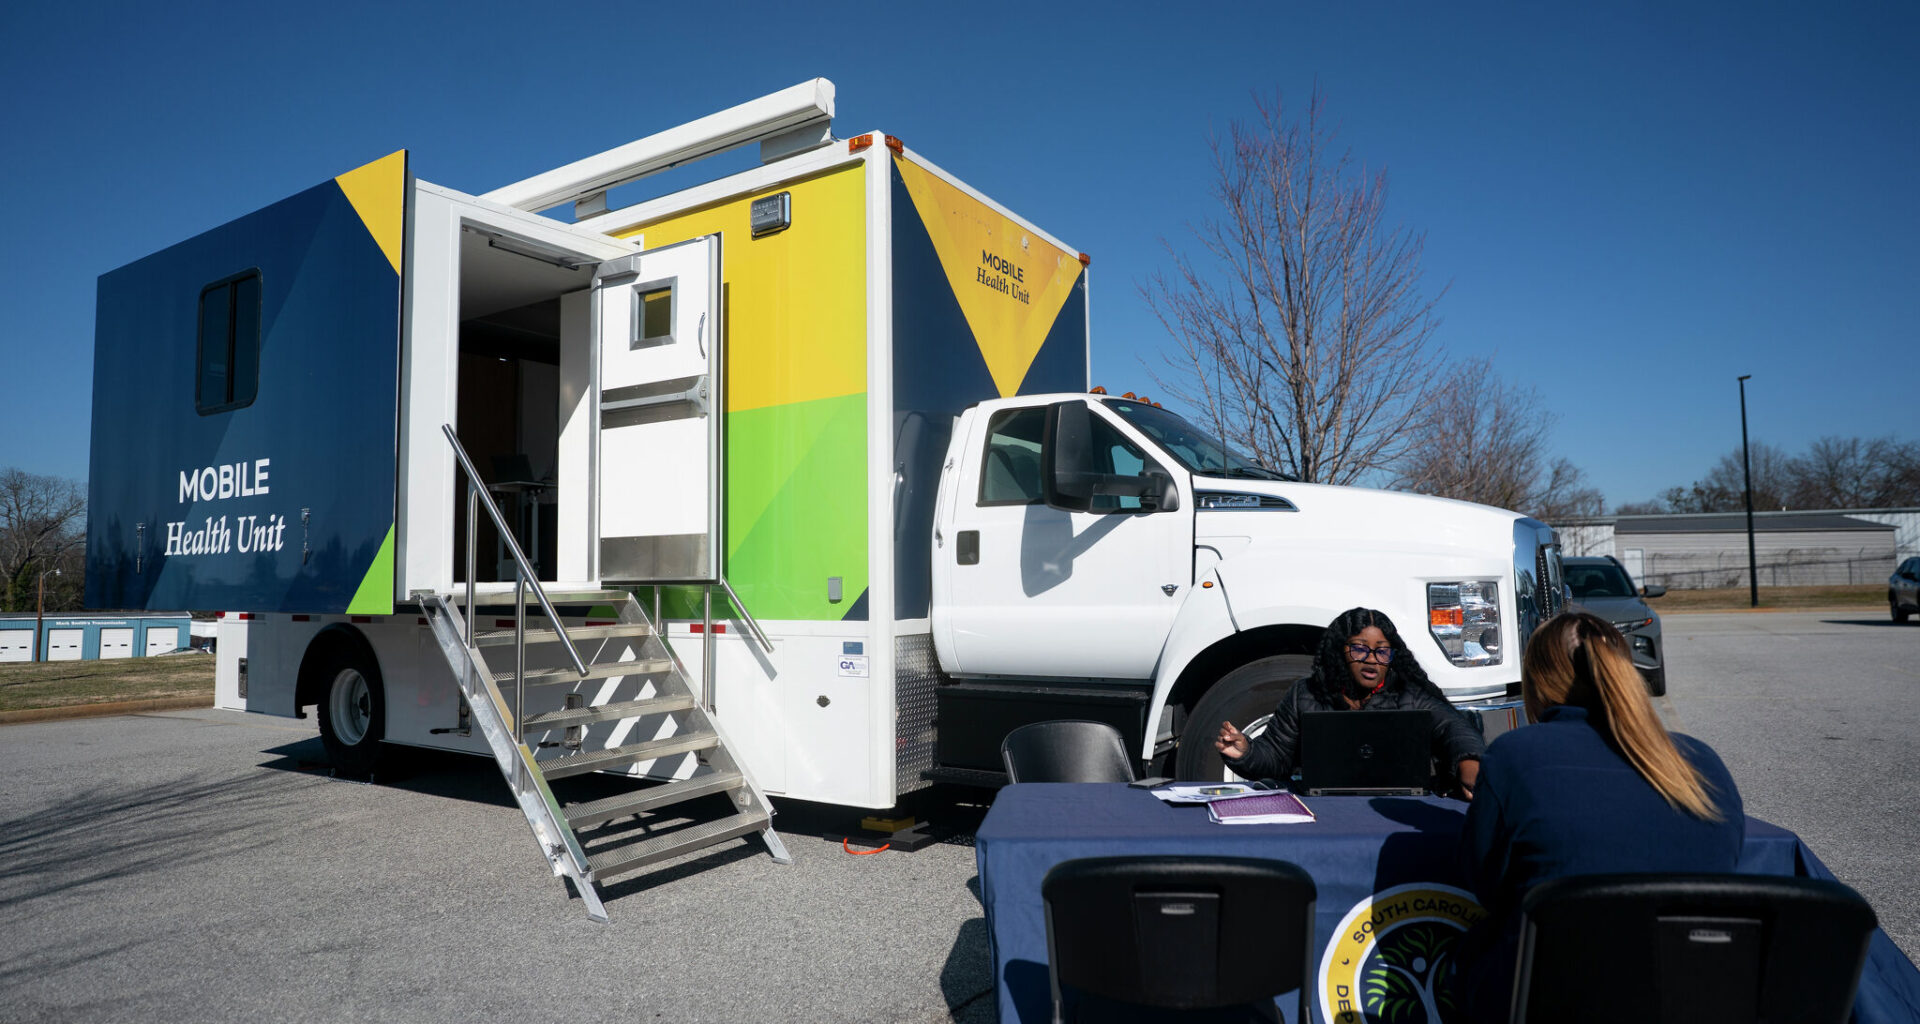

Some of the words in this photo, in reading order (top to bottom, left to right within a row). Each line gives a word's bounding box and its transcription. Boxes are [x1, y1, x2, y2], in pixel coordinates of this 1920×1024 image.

[976, 266, 1009, 295] Health
[1011, 282, 1030, 305] Unit
[982, 249, 1024, 283] MOBILE
[179, 458, 270, 504] MOBILE
[164, 515, 231, 556] Health
[237, 514, 286, 553] Unit
[1353, 901, 1409, 944] SOUTH
